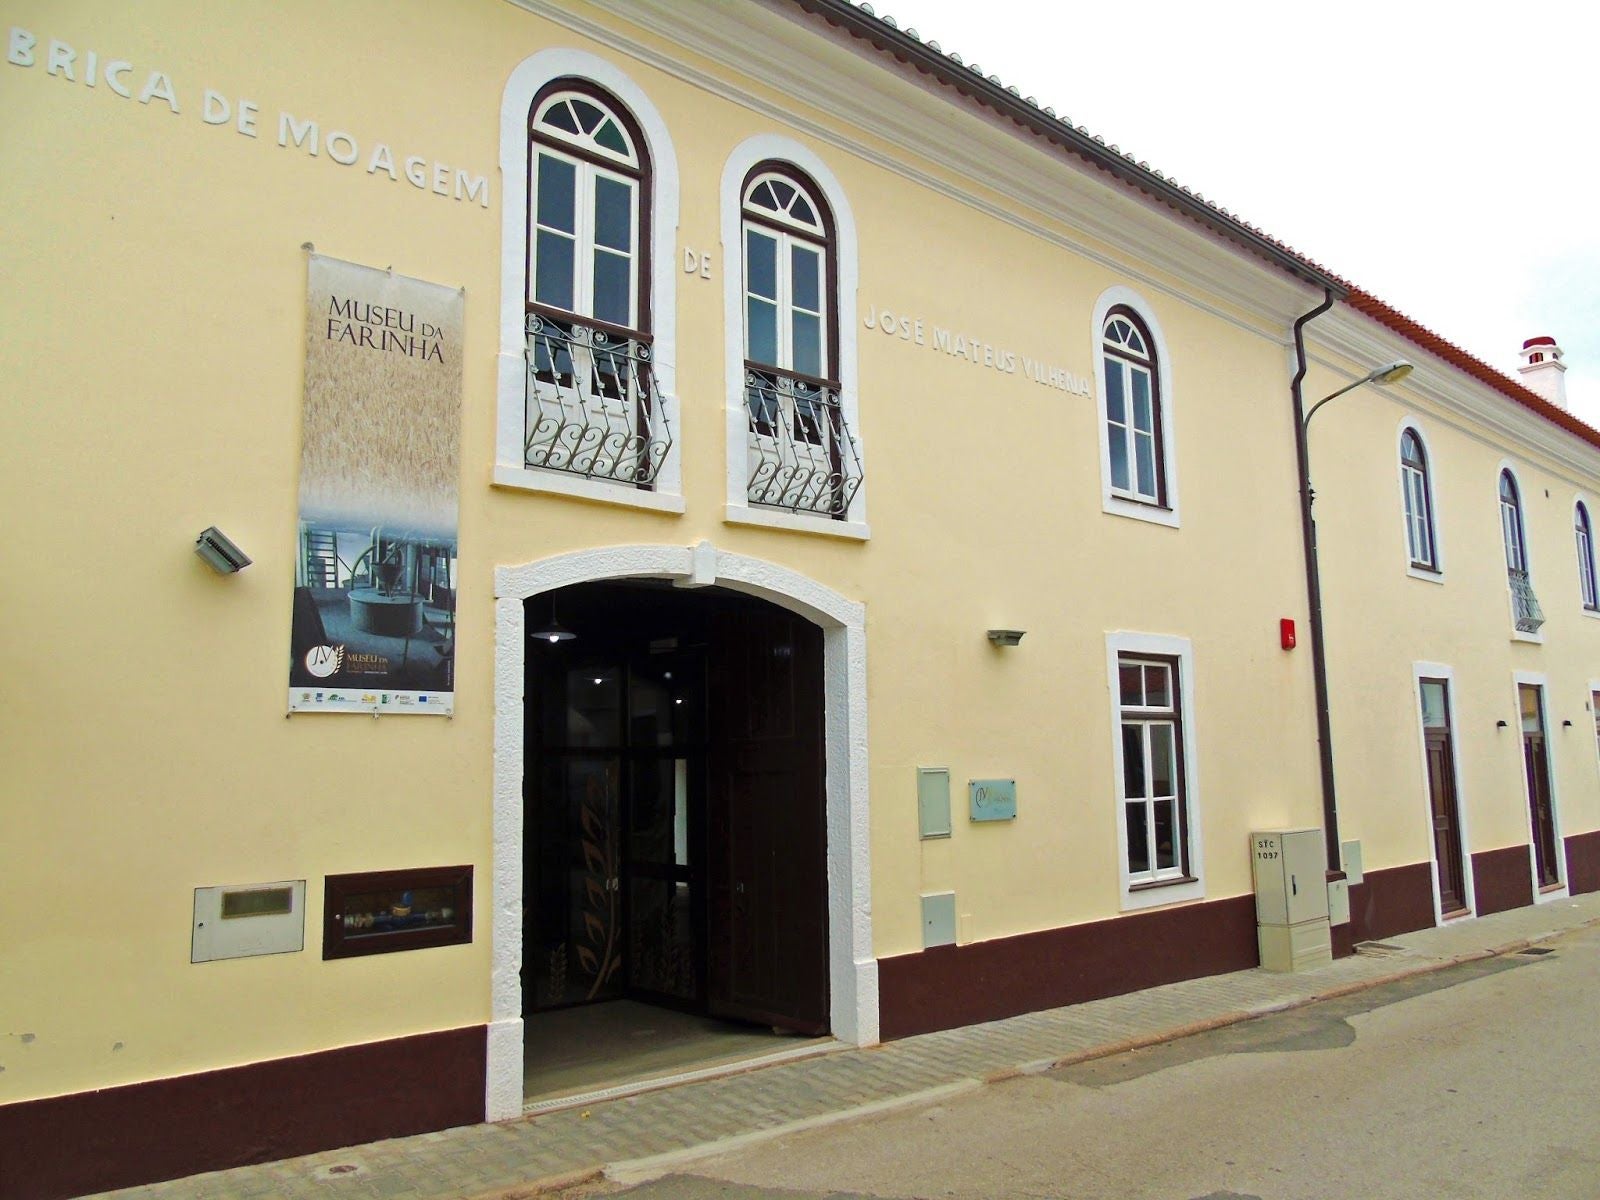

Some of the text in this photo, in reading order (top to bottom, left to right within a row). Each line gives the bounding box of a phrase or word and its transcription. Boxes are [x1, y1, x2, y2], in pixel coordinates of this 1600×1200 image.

[8, 26, 1092, 399] BRICA DE MOAGEM DE JOSÉ MATEUS VILHENA
[327, 318, 444, 364] FARINHA
[328, 295, 444, 341] MUSEU DA
[1258, 852, 1278, 860] 1097
